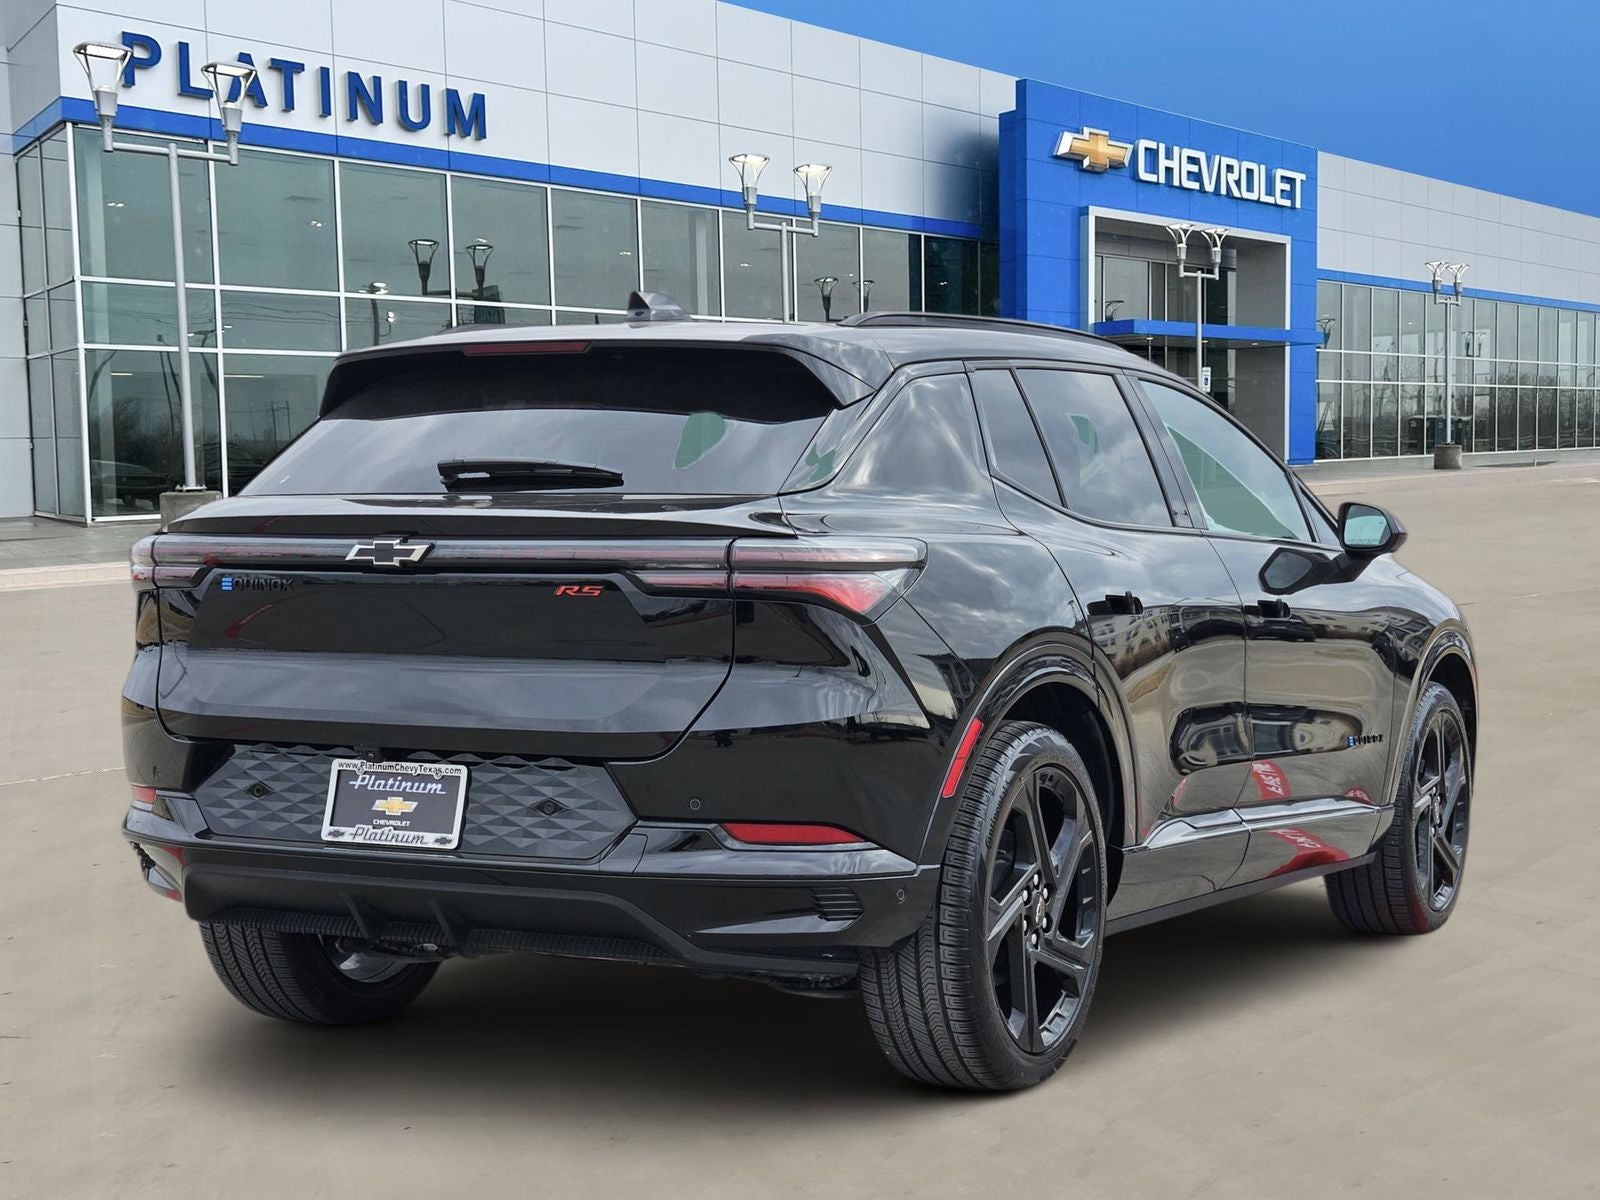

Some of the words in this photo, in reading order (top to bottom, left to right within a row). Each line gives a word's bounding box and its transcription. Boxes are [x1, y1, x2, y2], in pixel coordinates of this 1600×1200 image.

[120, 31, 487, 140] PLATINUM
[1136, 139, 1306, 208] CHEVROLET
[221, 576, 294, 591] EQUINOX
[555, 585, 602, 596] RS
[338, 761, 462, 775] www.PlatinumChevyTexas.com
[349, 776, 447, 795] Platinum
[373, 819, 410, 827] CHEVROLET
[349, 826, 427, 844] Platinum
